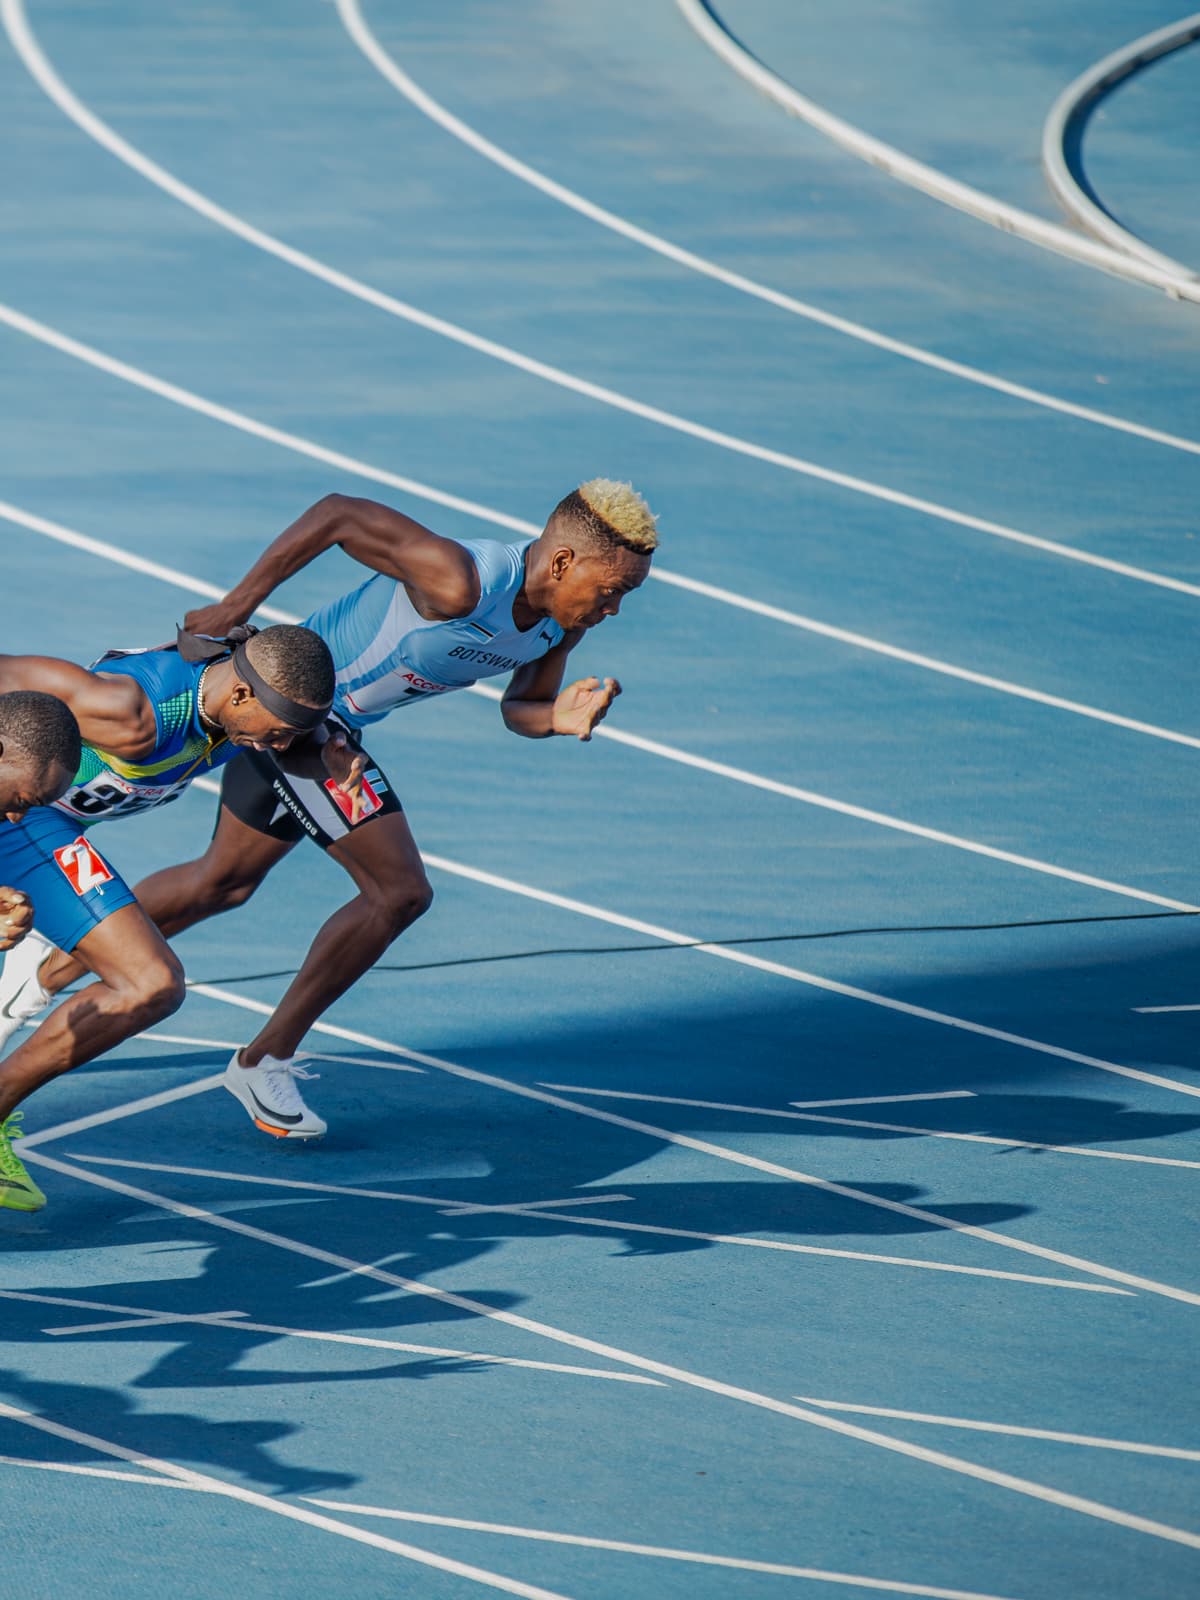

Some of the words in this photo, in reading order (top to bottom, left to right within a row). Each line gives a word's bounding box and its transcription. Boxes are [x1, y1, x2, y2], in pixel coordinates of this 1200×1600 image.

[448, 646, 525, 670] BOTSWAN
[273, 779, 318, 836] BOTSWANA
[61, 844, 106, 893] 2
